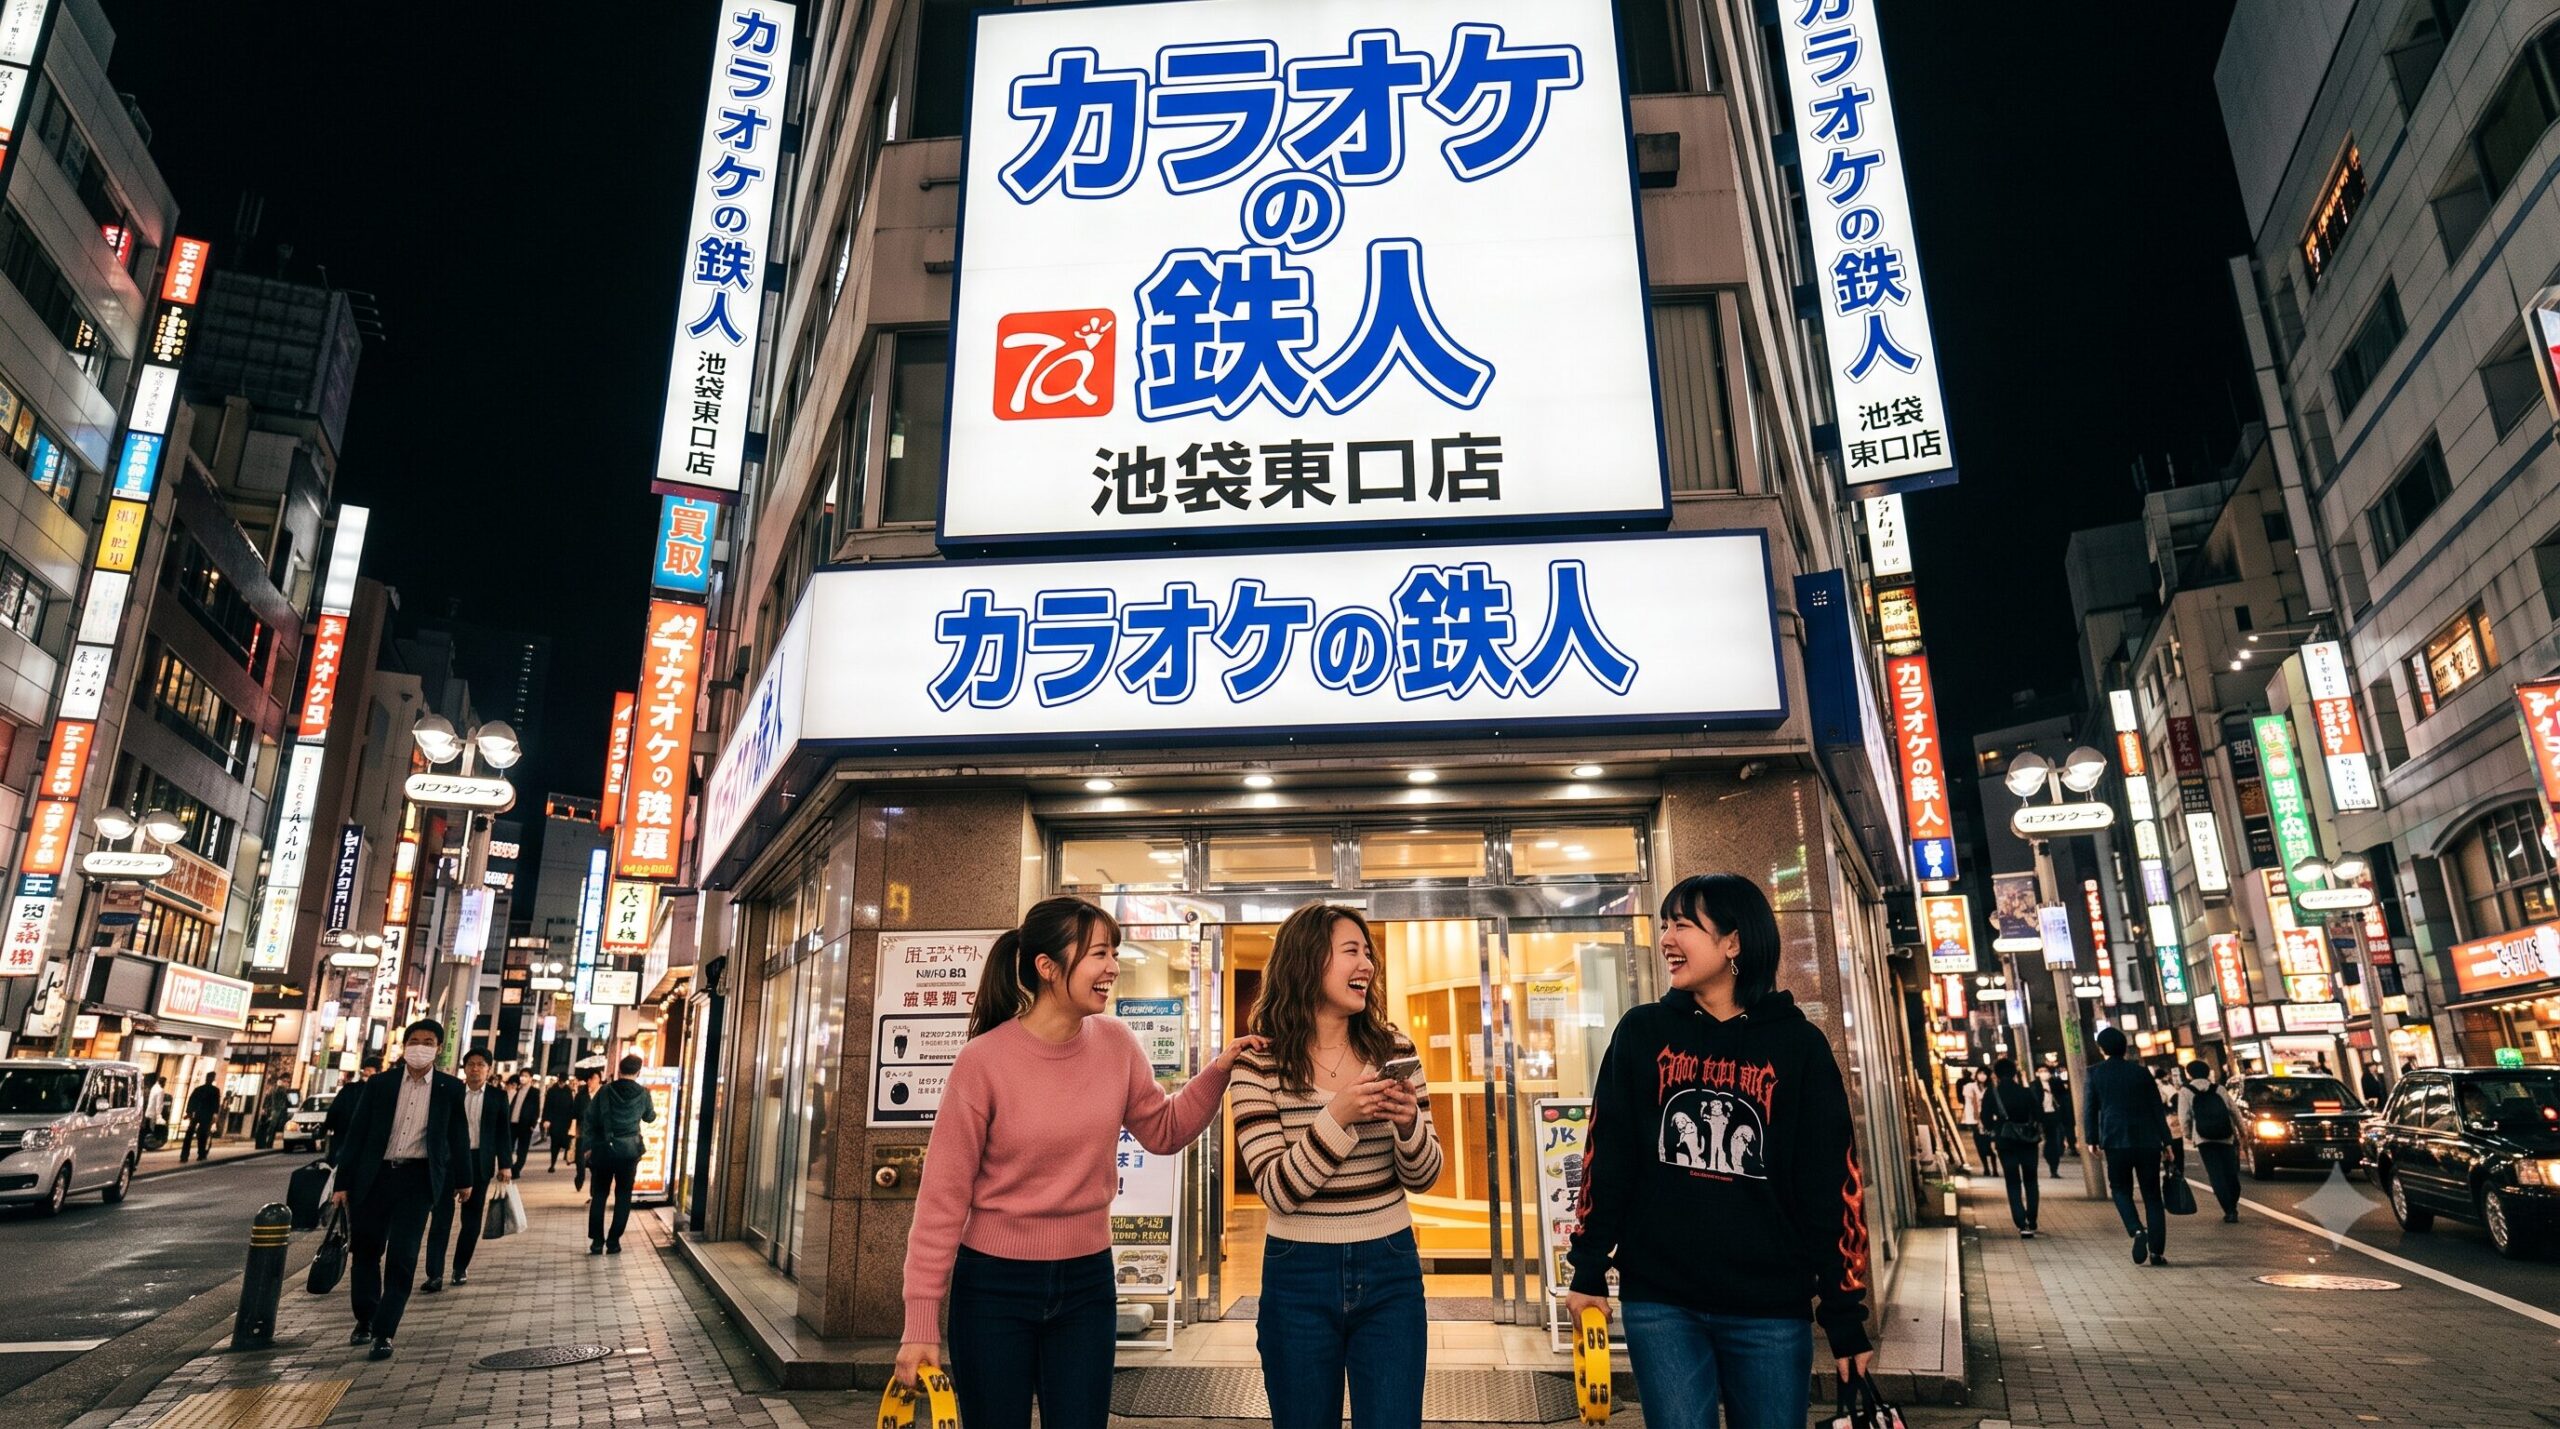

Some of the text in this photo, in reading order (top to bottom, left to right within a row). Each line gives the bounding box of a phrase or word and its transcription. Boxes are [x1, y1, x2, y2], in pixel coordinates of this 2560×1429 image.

[1000, 22, 1583, 205] カラオケ
[685, 9, 781, 347] カラオケの鉄人
[1241, 168, 1345, 254] の
[1134, 236, 1496, 422] 鉄人
[686, 351, 726, 476] 池袋東口店
[1091, 432, 1504, 517] 池袋東口店
[1849, 430, 1942, 469] 東口店
[1859, 396, 1924, 432] 池袋
[662, 498, 708, 578] 買取
[929, 558, 1638, 713] カラオケの鉄人
[1896, 662, 1945, 828] カラオケの鉄人
